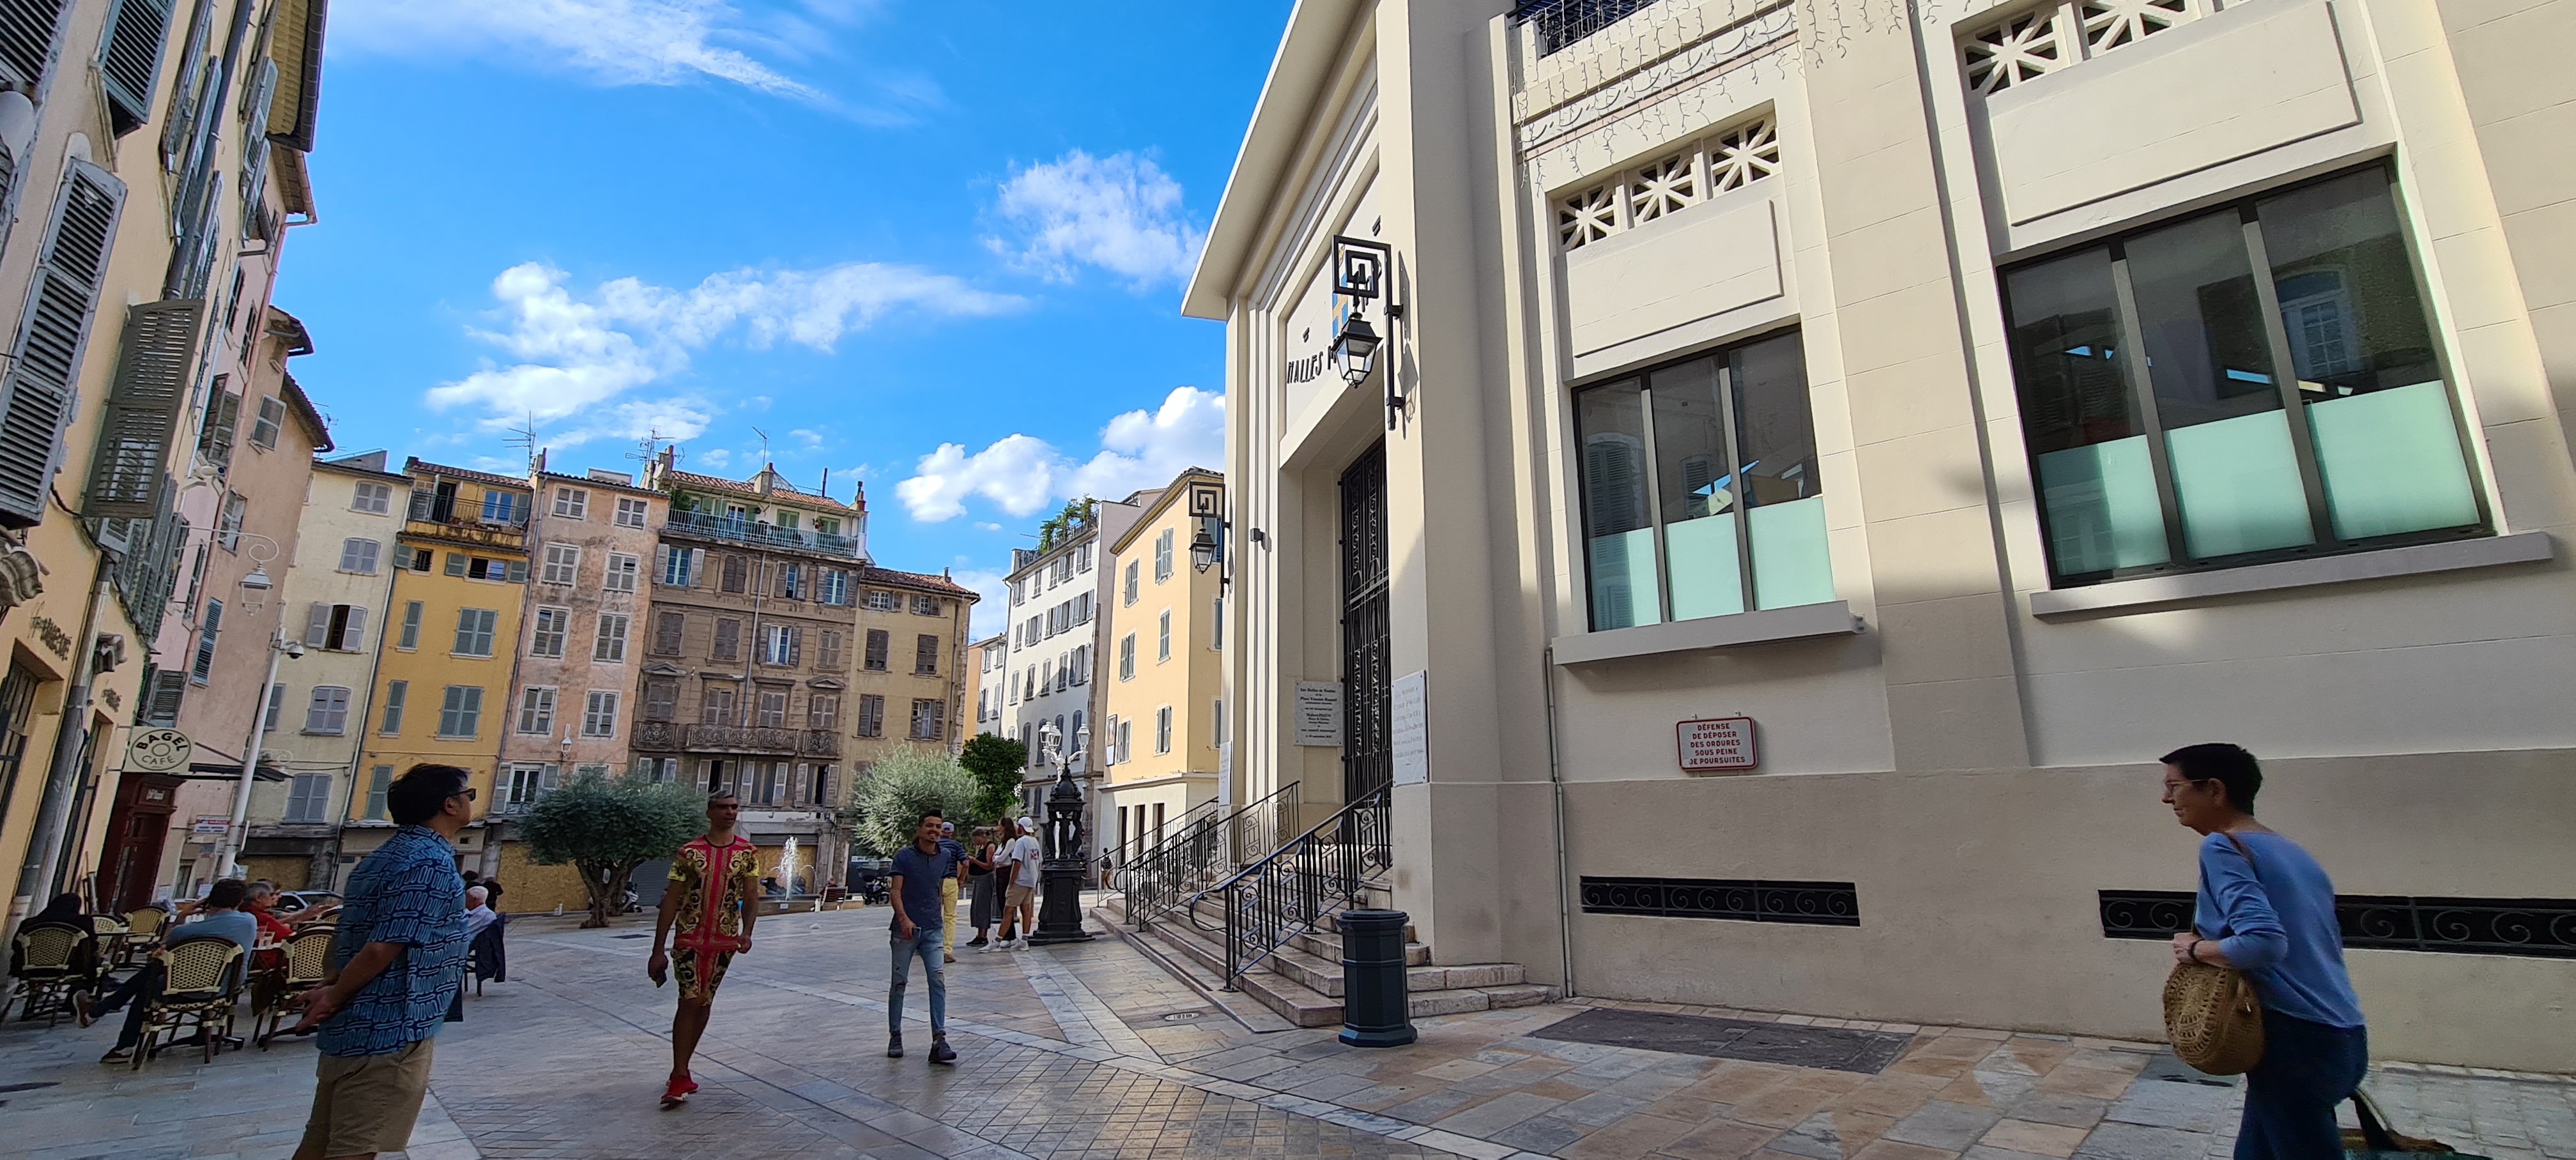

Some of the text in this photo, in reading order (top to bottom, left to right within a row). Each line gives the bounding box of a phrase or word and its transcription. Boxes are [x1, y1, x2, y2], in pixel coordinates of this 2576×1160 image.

[1287, 351, 1323, 384] HALLES
[135, 733, 188, 752] BAGEL
[1699, 756, 1745, 765] POURSUITES
